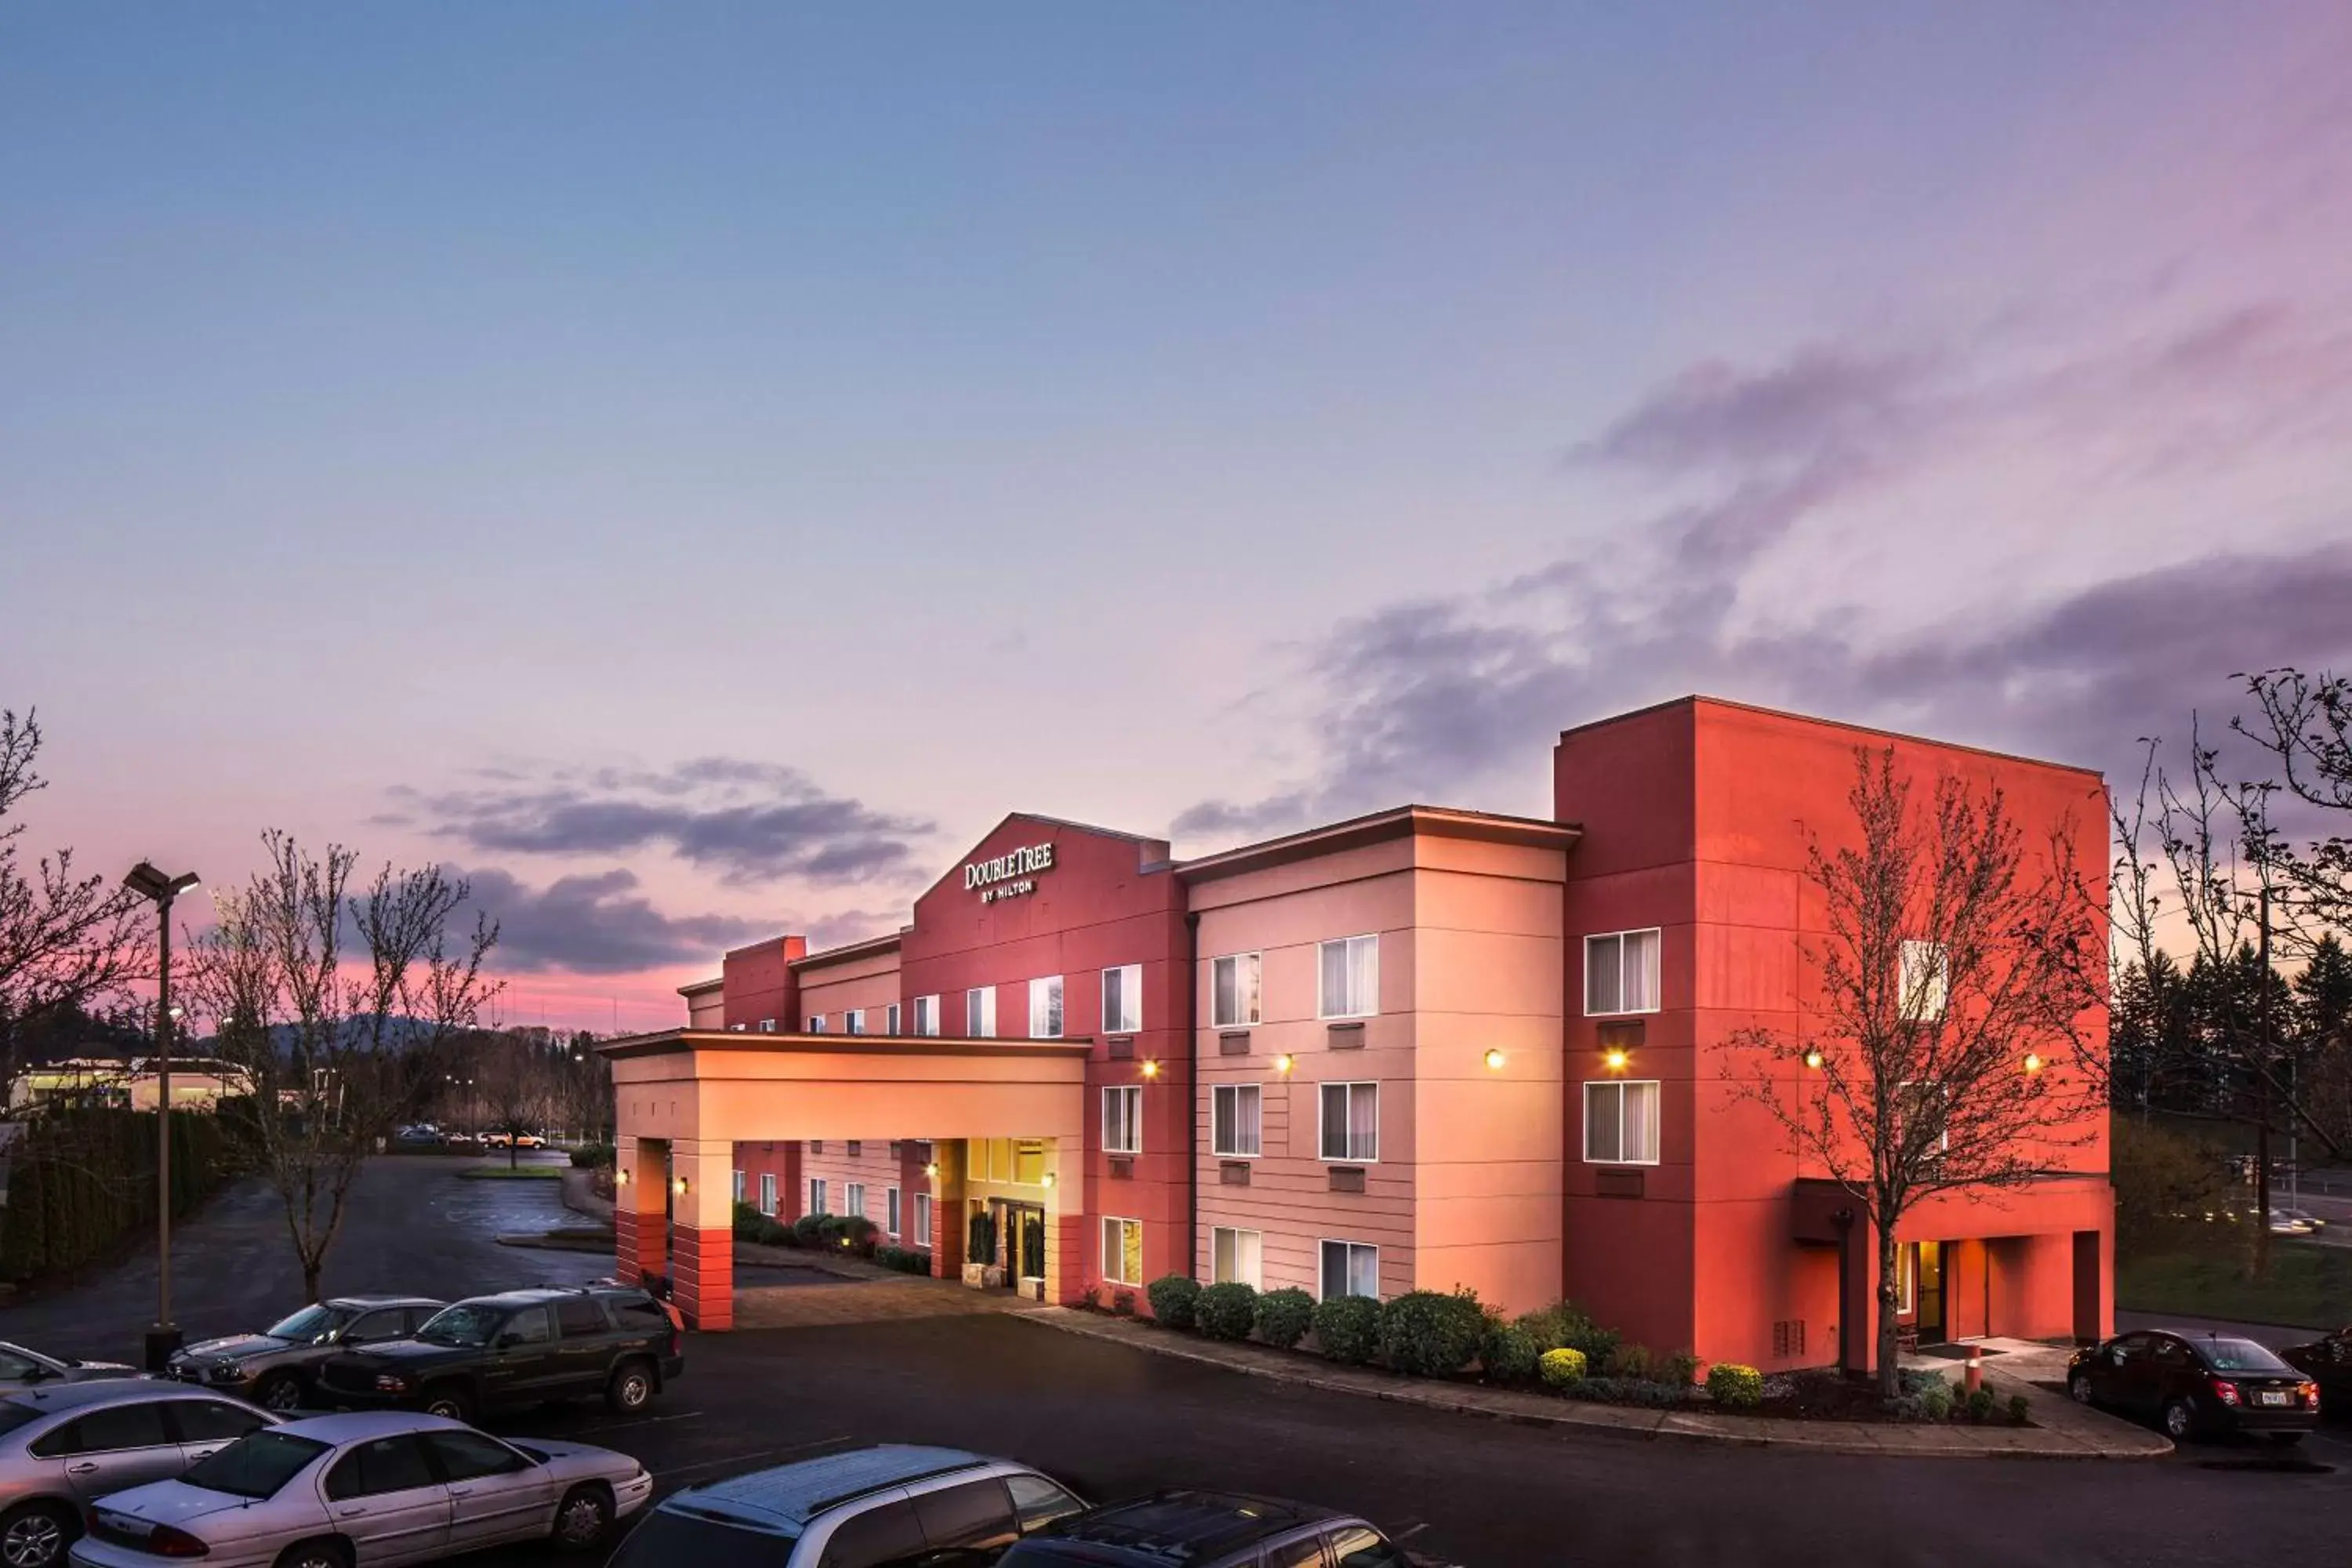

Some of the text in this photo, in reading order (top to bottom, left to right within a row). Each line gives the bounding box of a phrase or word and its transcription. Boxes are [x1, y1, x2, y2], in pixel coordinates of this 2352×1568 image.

[964, 844, 1052, 890] DOUBLETREE
[981, 880, 1032, 903] BY HILTON
